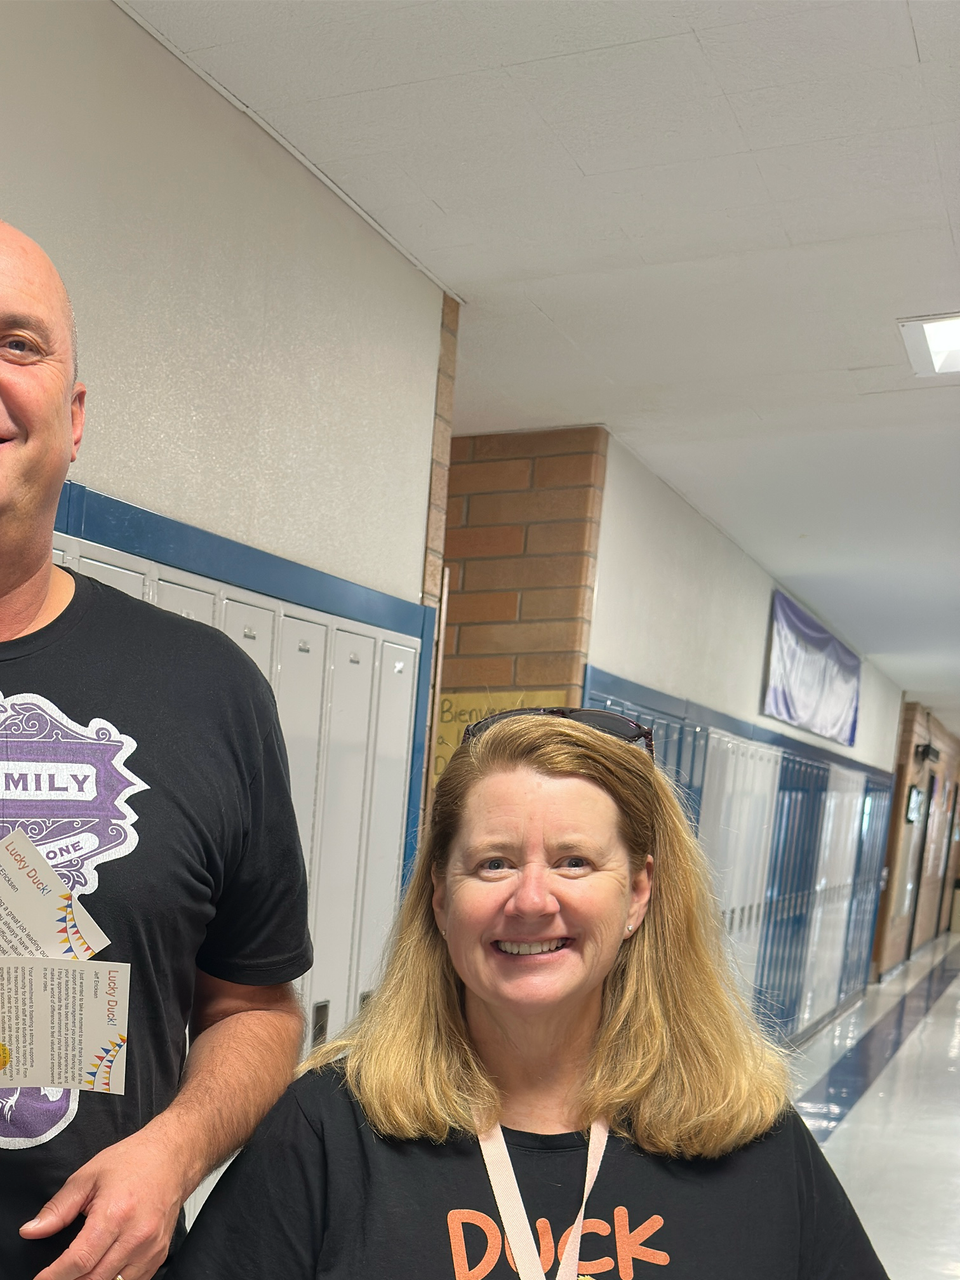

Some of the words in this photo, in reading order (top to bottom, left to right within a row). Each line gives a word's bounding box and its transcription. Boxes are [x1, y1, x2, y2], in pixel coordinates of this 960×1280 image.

[5, 841, 29, 870] Lucky
[26, 868, 52, 896] Duck!
[2, 920, 19, 939] always
[17, 936, 29, 951] have
[5, 910, 21, 925] great
[16, 923, 27, 934] job
[25, 931, 42, 952] leading
[105, 970, 119, 997] Lucky
[107, 1000, 118, 1026] Duck!
